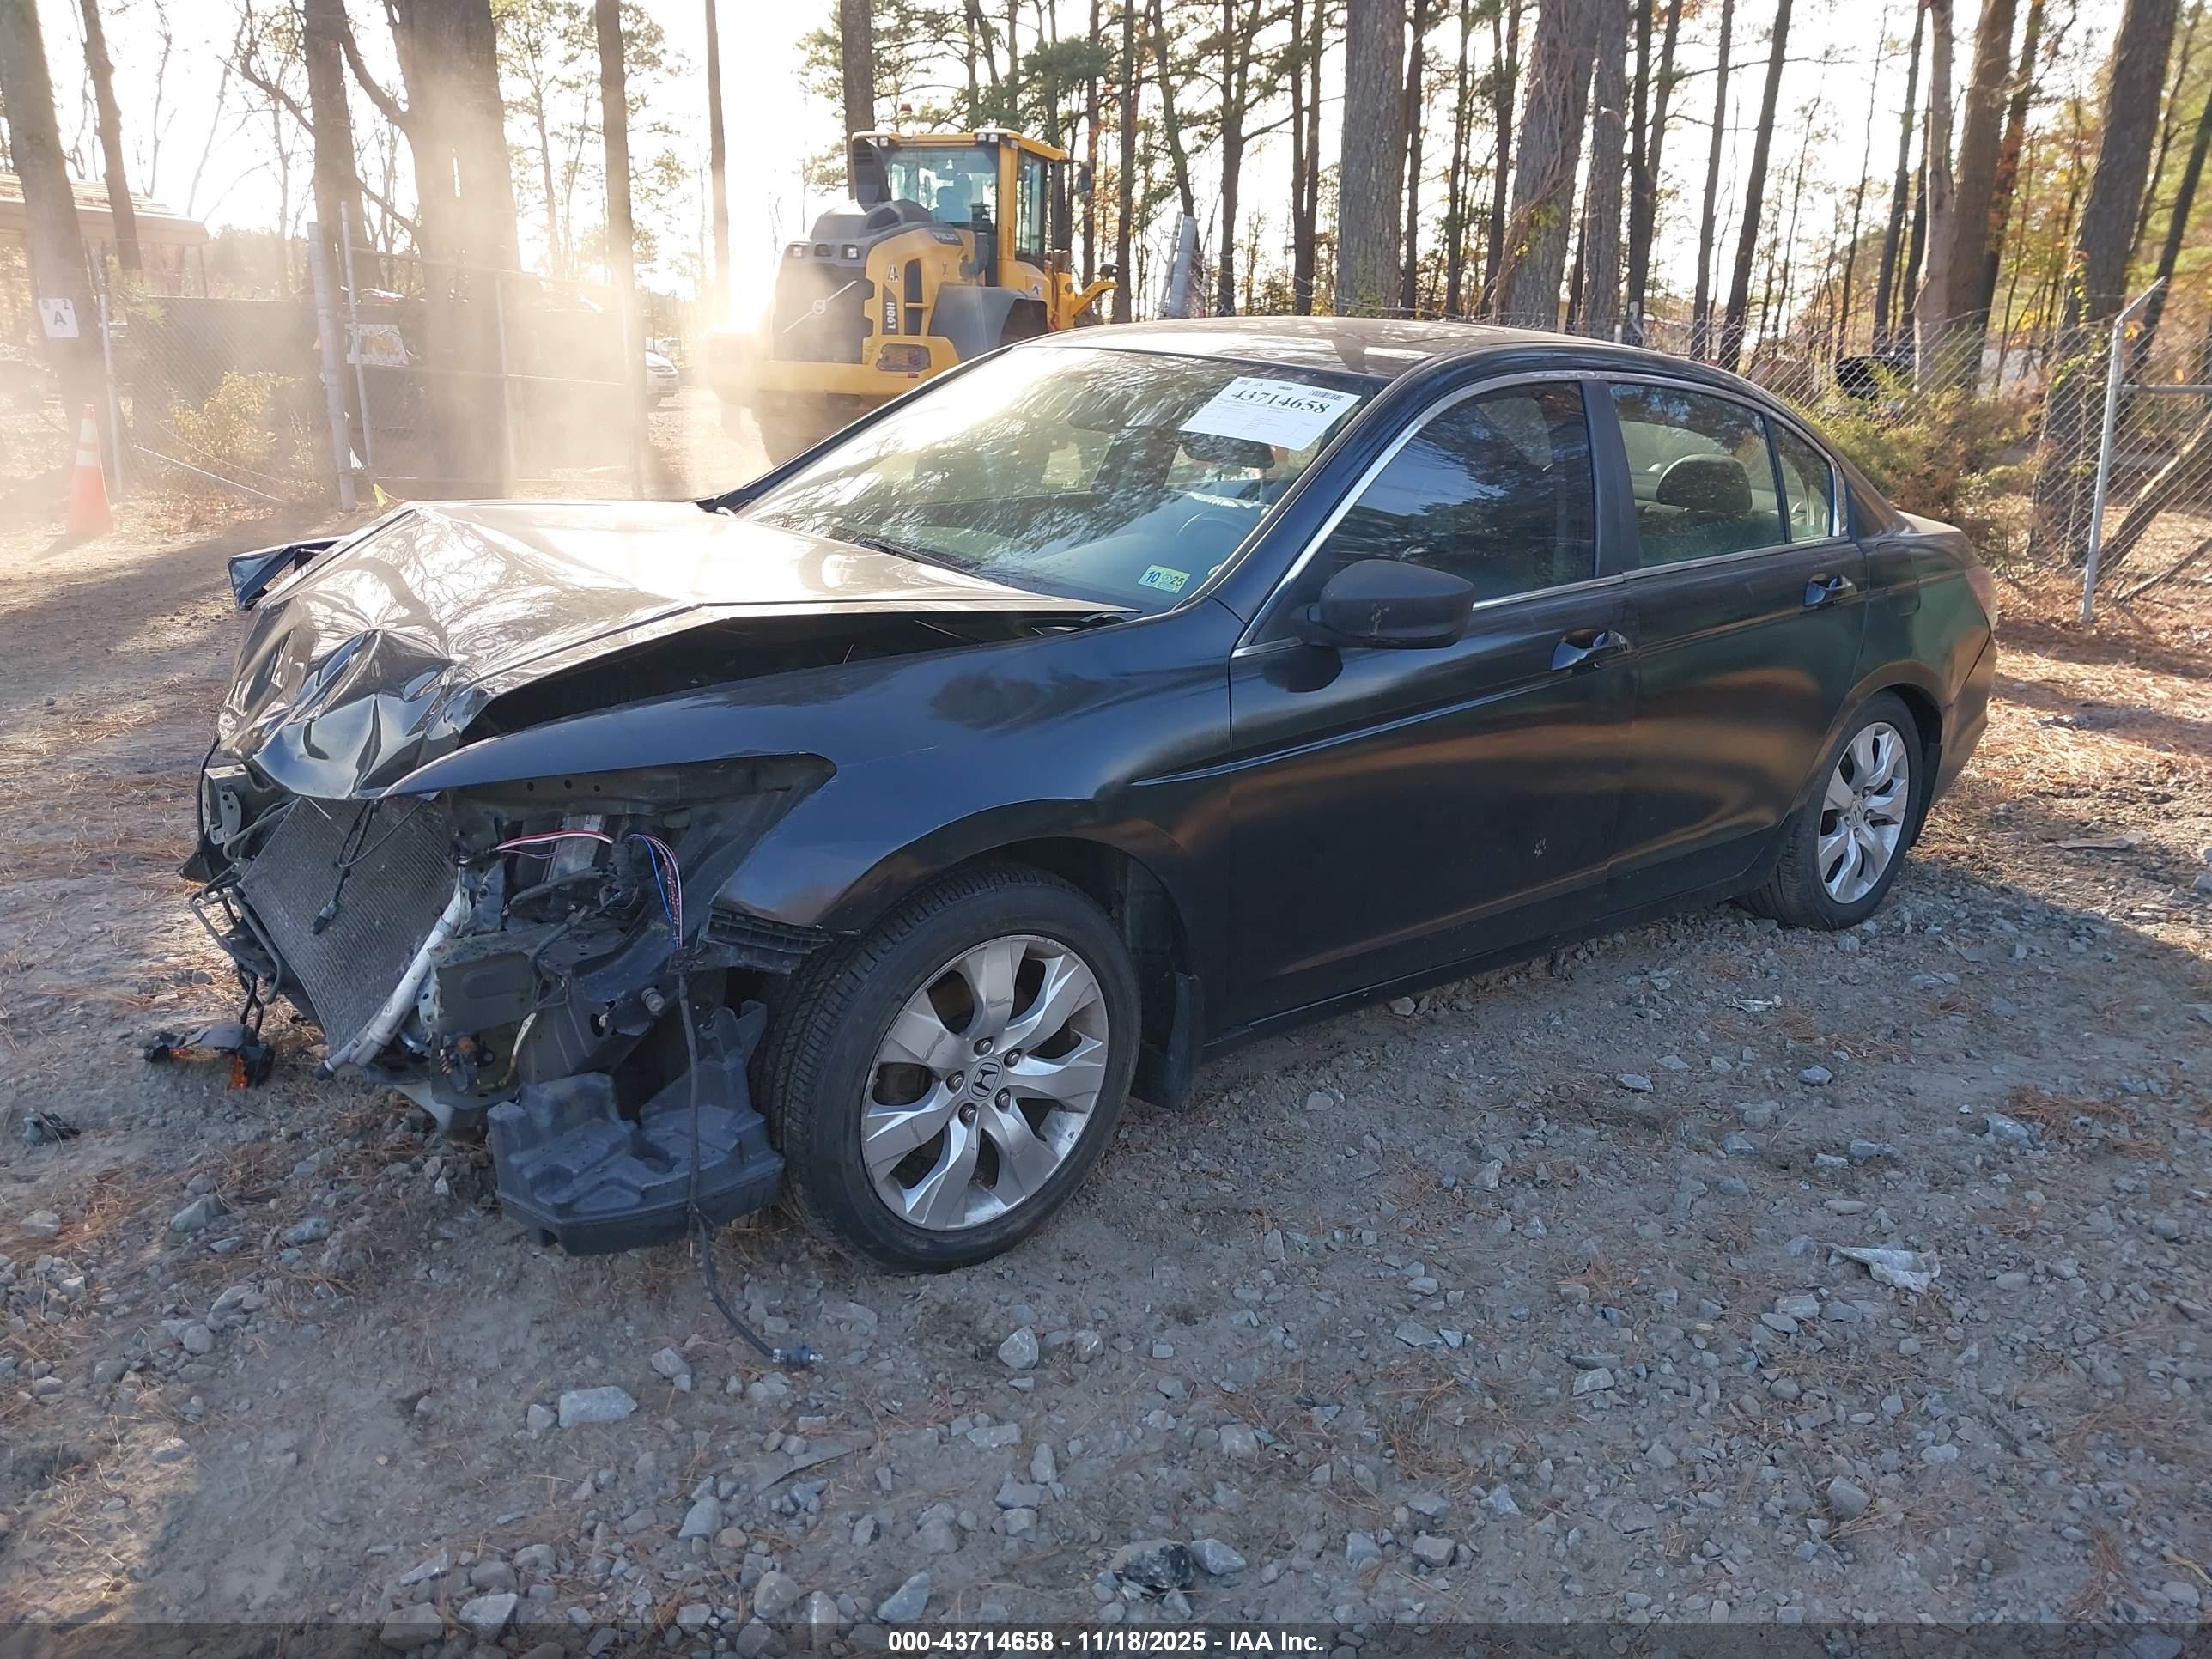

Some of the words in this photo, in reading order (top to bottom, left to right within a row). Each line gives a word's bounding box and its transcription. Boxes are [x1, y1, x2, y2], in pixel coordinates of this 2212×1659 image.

[54, 310, 68, 325] A
[885, 301, 896, 330] L90H
[1231, 389, 1331, 414] 43714658
[1146, 571, 1161, 583] 10
[1170, 575, 1185, 586] 25
